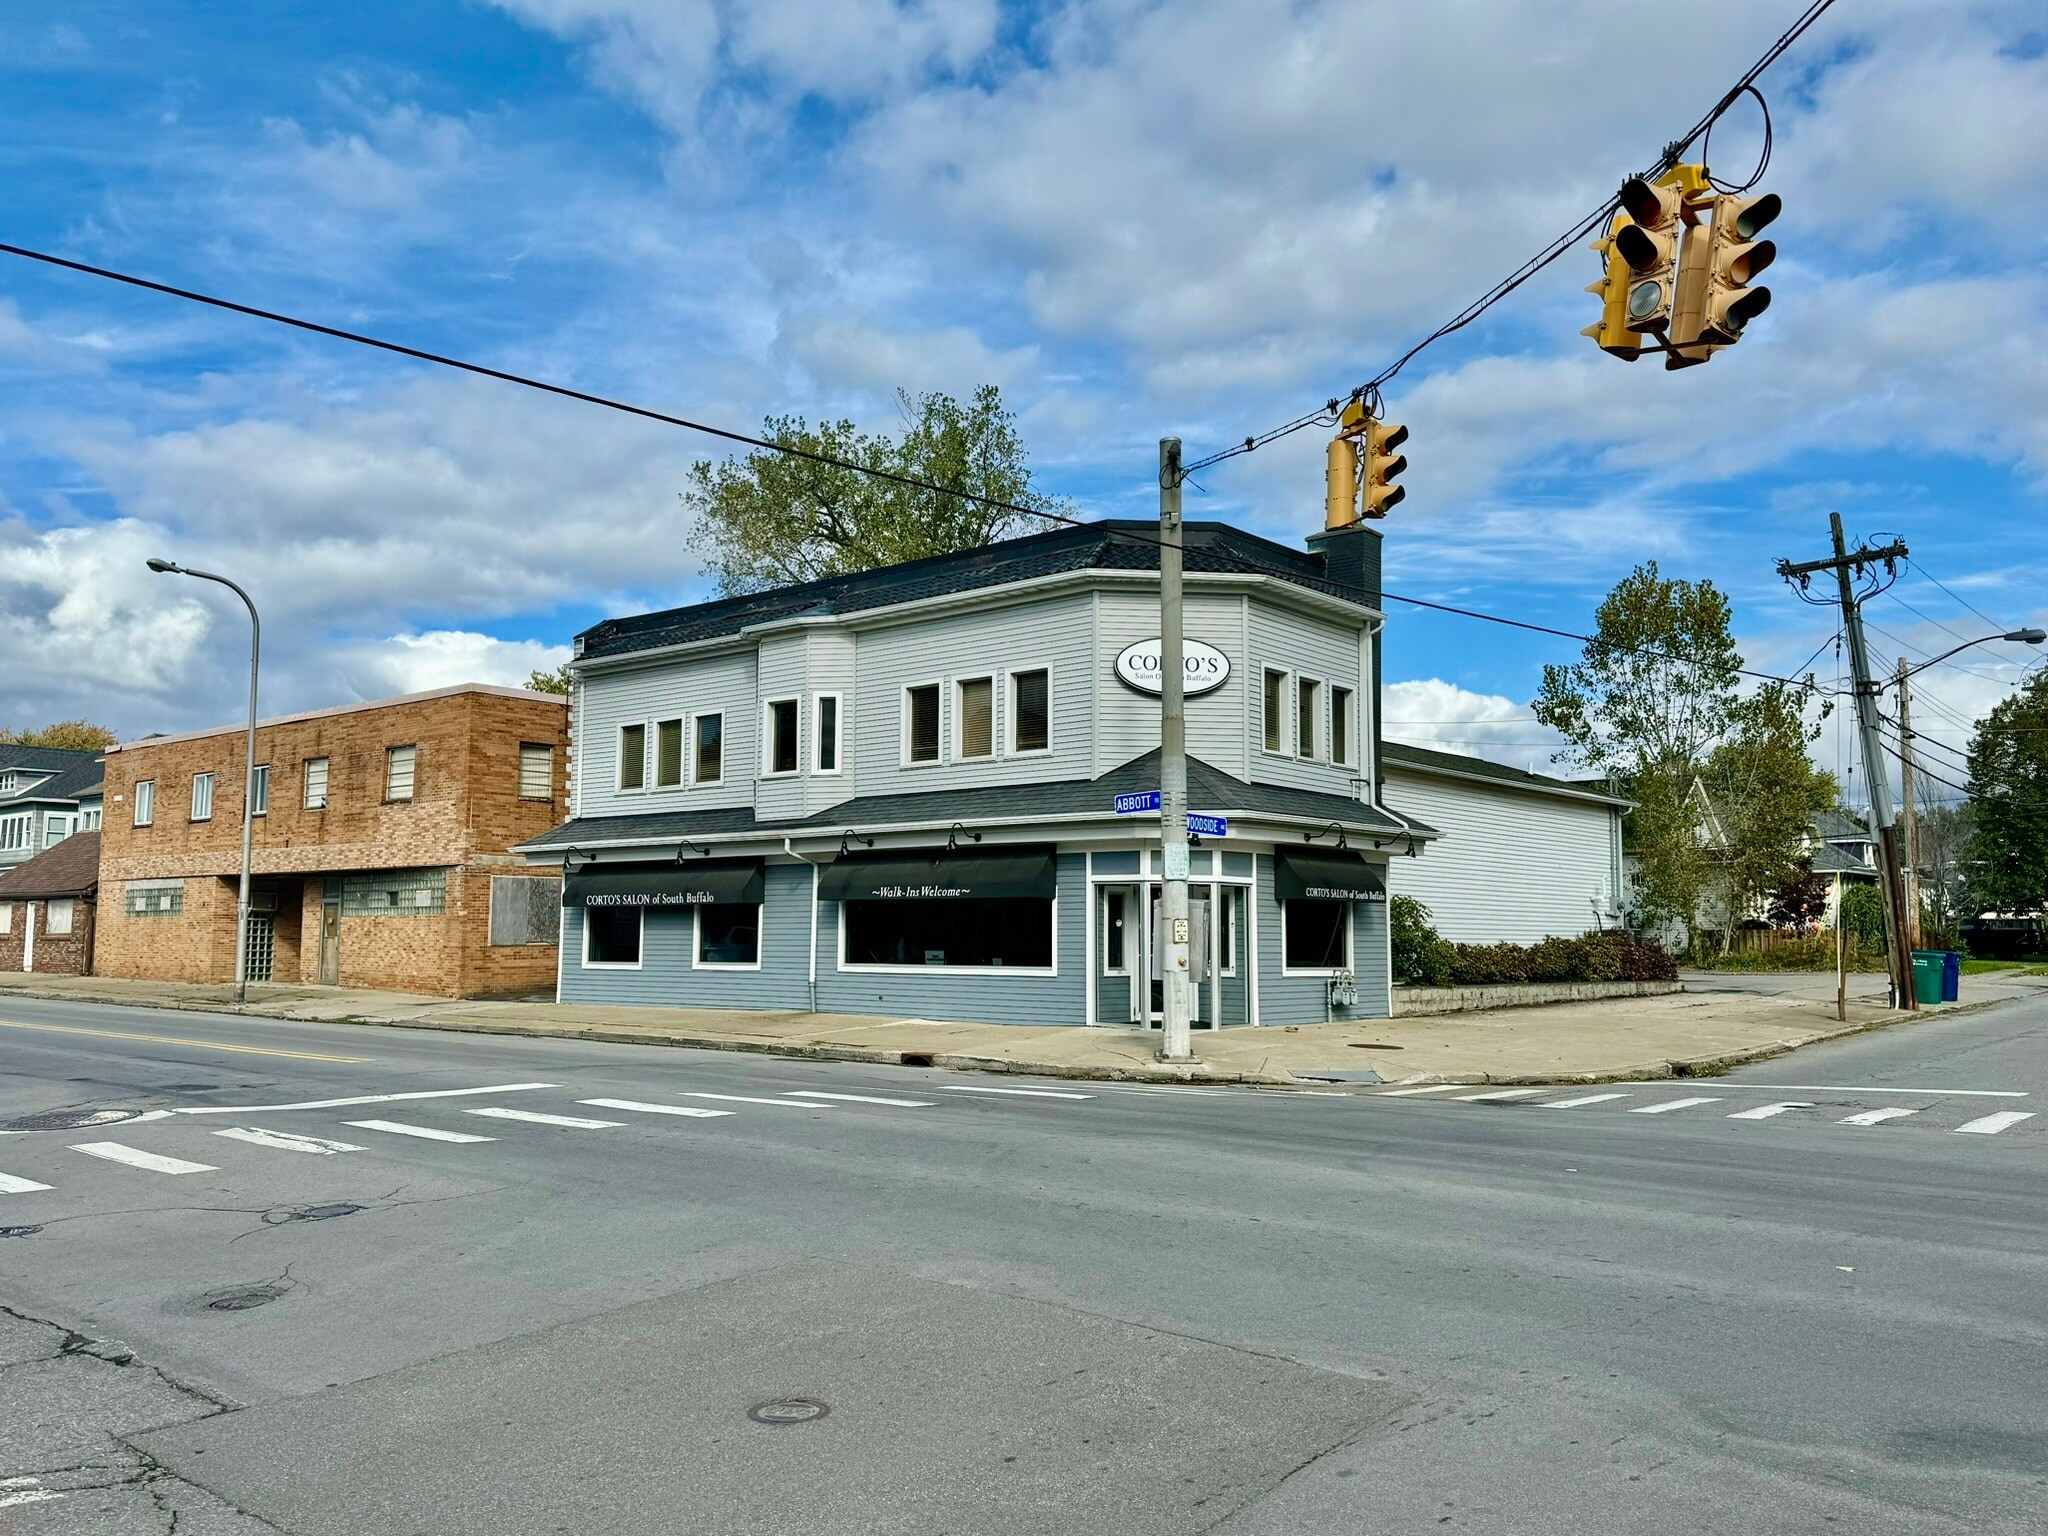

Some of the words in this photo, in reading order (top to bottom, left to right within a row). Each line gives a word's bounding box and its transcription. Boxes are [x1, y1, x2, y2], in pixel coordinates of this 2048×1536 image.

[1128, 654, 1218, 674] COO'S
[1135, 672, 1154, 680] Salon
[1186, 674, 1212, 682] Buffalo
[1117, 795, 1151, 811] ABBOTT
[586, 894, 621, 906] CORTO'S
[622, 893, 650, 905] SALON
[652, 893, 660, 904] of
[662, 892, 684, 904] South
[686, 891, 715, 903] Buffalo
[1306, 887, 1330, 898] CORTO'S
[1330, 888, 1348, 899] SALON
[1349, 890, 1355, 899] of
[1355, 891, 1368, 900] South
[1369, 891, 1385, 900] Buffalo
